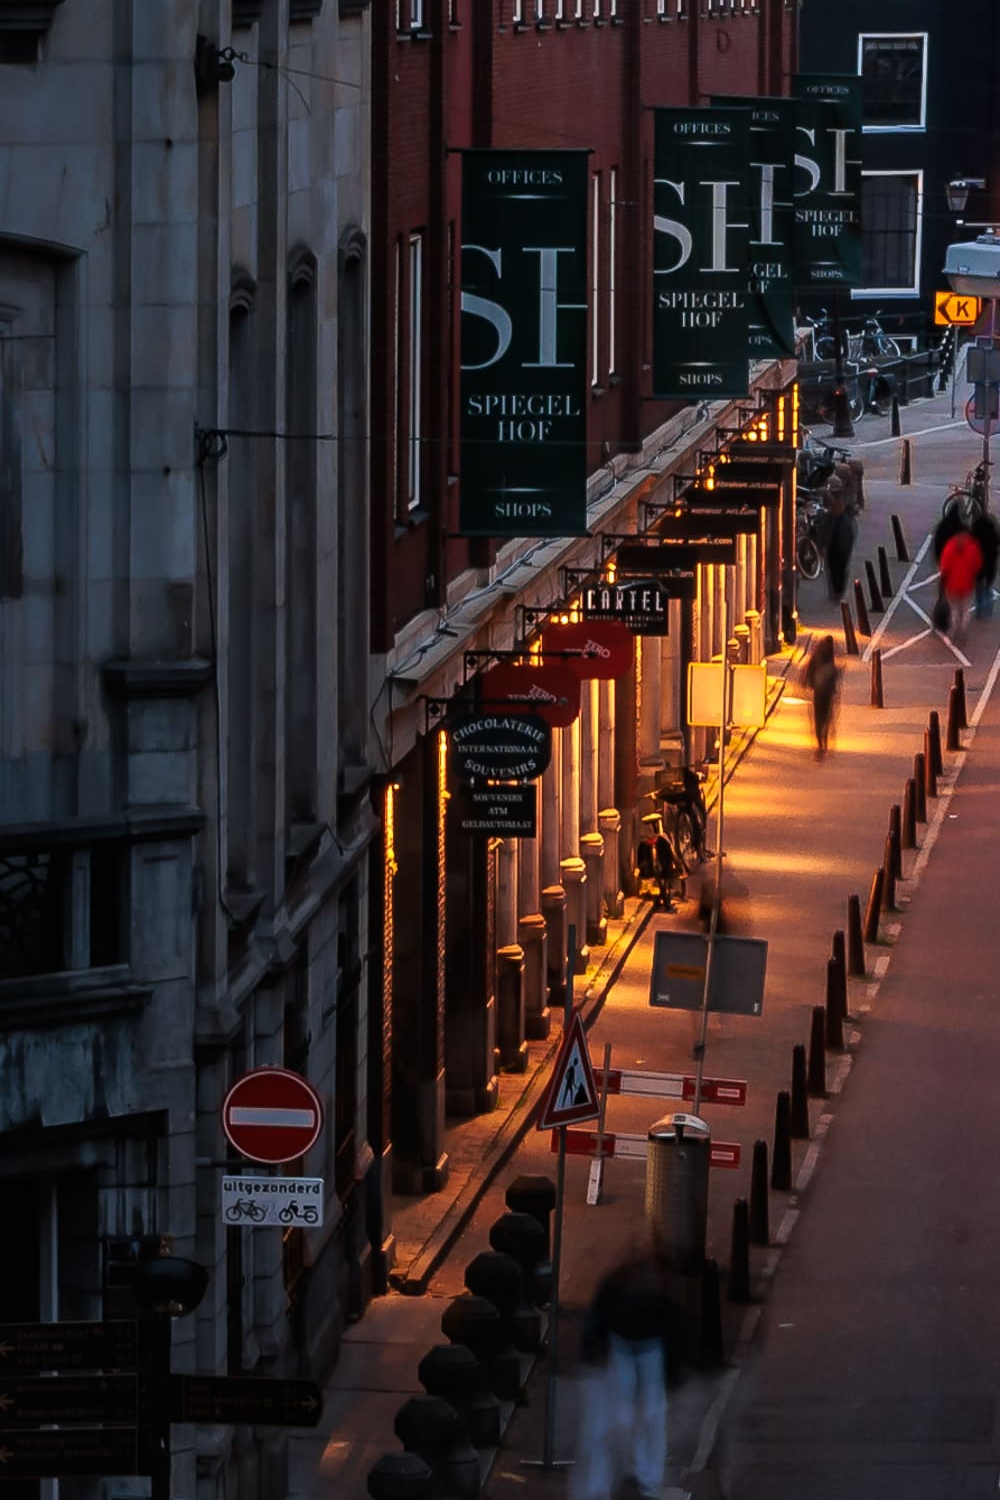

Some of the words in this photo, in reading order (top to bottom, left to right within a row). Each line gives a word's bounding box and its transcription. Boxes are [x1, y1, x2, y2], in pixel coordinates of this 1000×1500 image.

[806, 85, 849, 94] OFFICES
[673, 123, 731, 135] OFFICES
[487, 170, 563, 184] OFFICES
[795, 211, 858, 222] SPIEGEL
[811, 224, 843, 236] HOF
[811, 269, 842, 278] SHOPS
[659, 291, 745, 308] SPIEGEL
[956, 301, 970, 318] K
[681, 311, 724, 328] HOF
[679, 372, 723, 385] SHOPS
[468, 395, 581, 416] SPIEGEL
[497, 420, 553, 441] HOF
[495, 502, 551, 517] SHOPS
[587, 589, 664, 611] CARTEL
[452, 718, 545, 742] CHOCOLATERIE
[457, 745, 539, 754] INTERNATIONAAL
[464, 758, 537, 778] SOUVENIRS
[472, 793, 523, 802] SOUVENIRS
[488, 807, 508, 815] ATM
[462, 820, 532, 828] GELDAUTOMAAT
[223, 1181, 321, 1195] uitgezonderd
